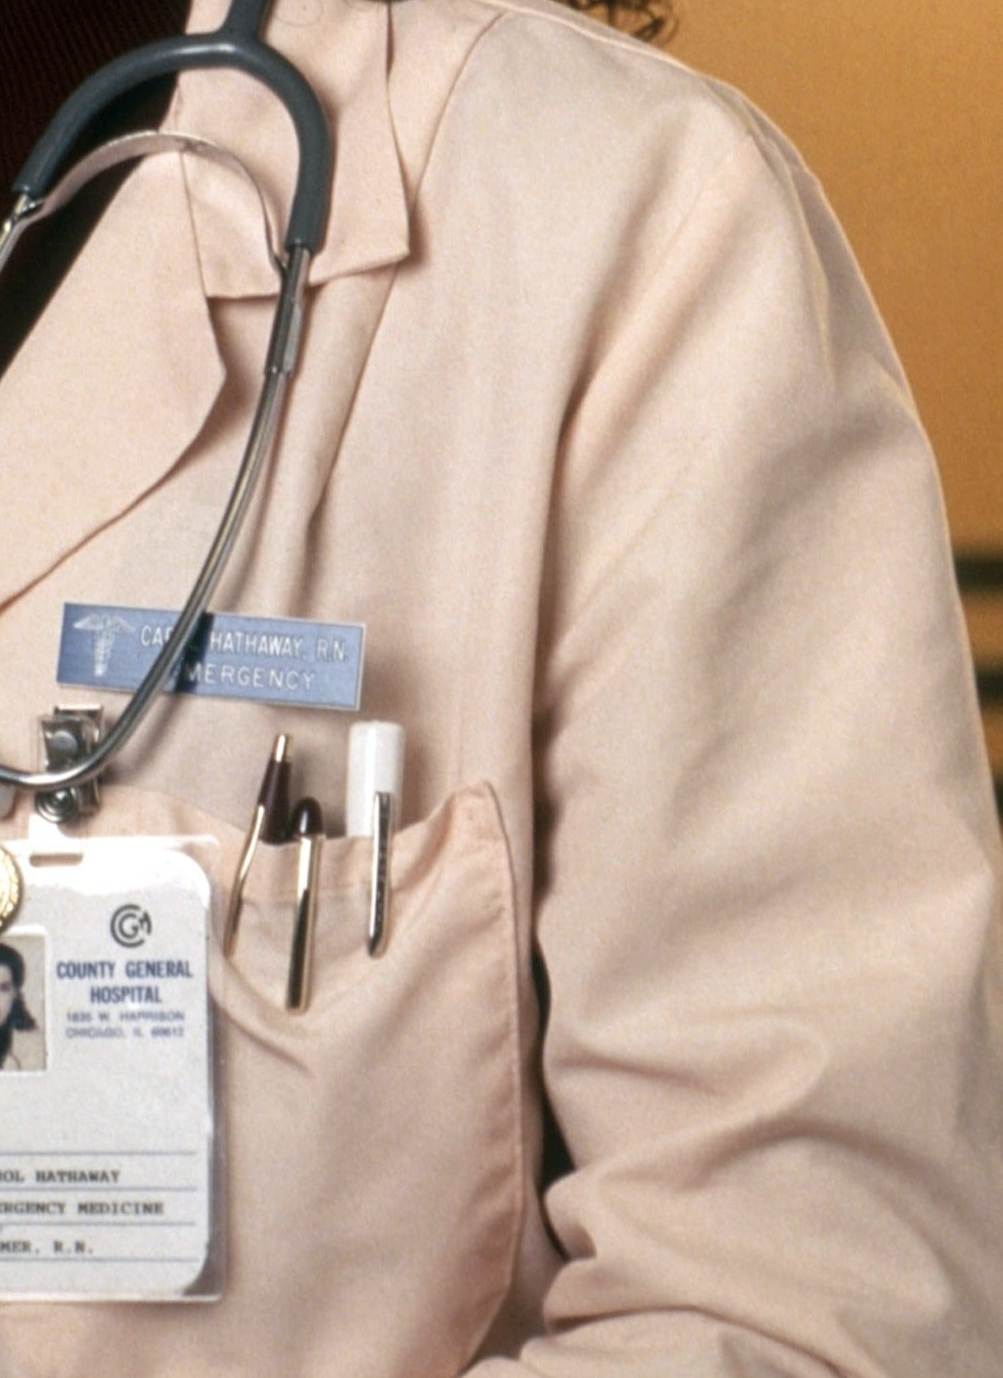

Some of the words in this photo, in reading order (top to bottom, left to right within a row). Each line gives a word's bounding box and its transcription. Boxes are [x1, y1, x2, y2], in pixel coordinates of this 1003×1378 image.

[174, 661, 315, 690] MERGENCY
[56, 961, 115, 979] COUNTY
[125, 960, 193, 979] GENERAL
[90, 986, 162, 1004] HOSPITAL
[35, 1170, 121, 1183] HATHAWAY
[78, 1202, 164, 1215] MEDICINE
[53, 1240, 94, 1254] R.N.
